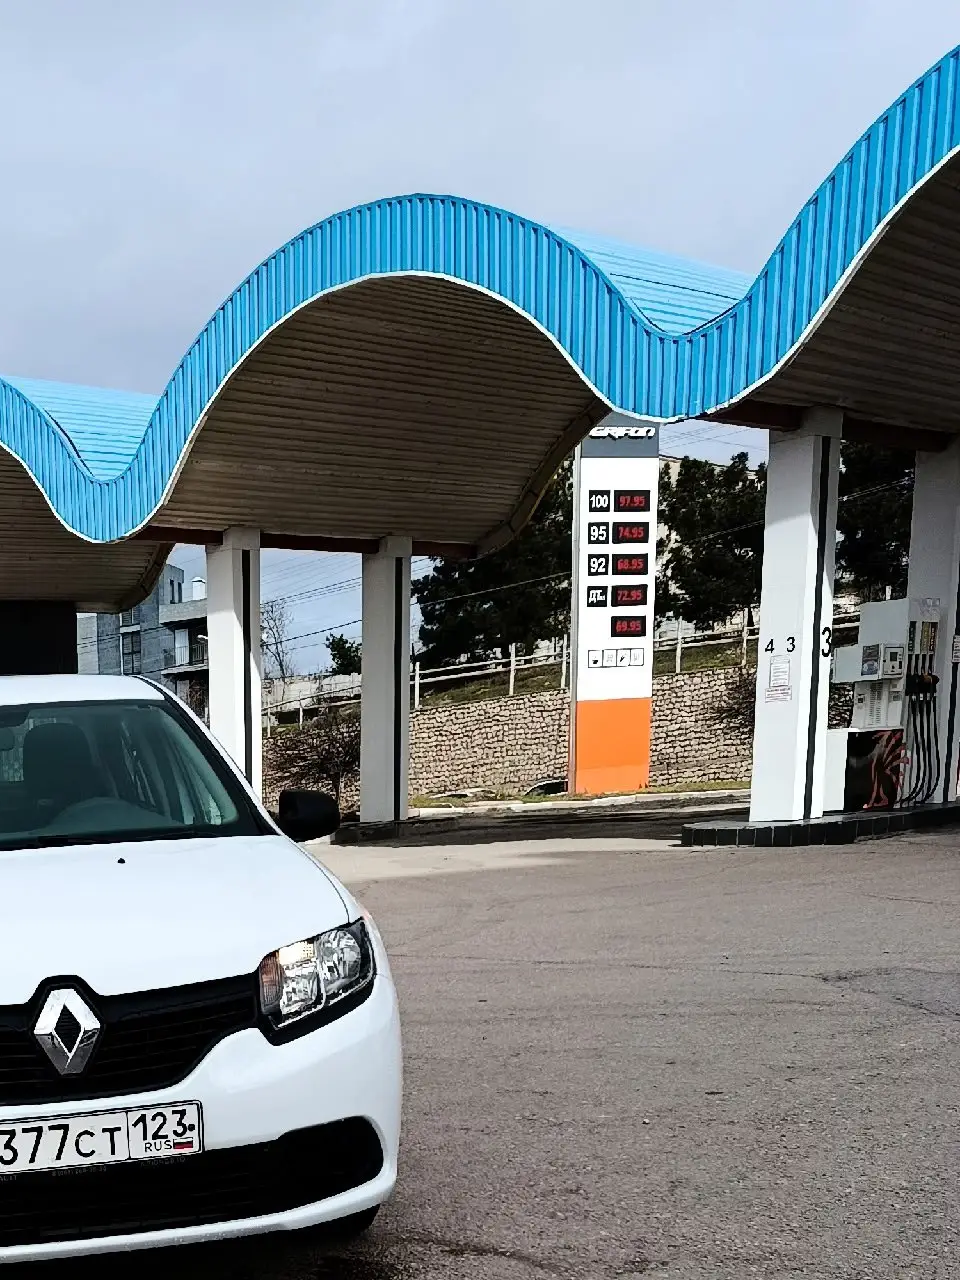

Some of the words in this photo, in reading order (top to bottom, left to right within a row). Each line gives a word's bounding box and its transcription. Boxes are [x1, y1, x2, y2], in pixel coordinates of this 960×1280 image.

[590, 495, 609, 508] 100
[590, 526, 607, 541] 95
[590, 557, 606, 573] 92
[765, 638, 775, 654] 4
[786, 636, 796, 653] 3
[821, 627, 832, 657] 3
[132, 1109, 188, 1141] 123
[145, 1140, 172, 1152] RUS
